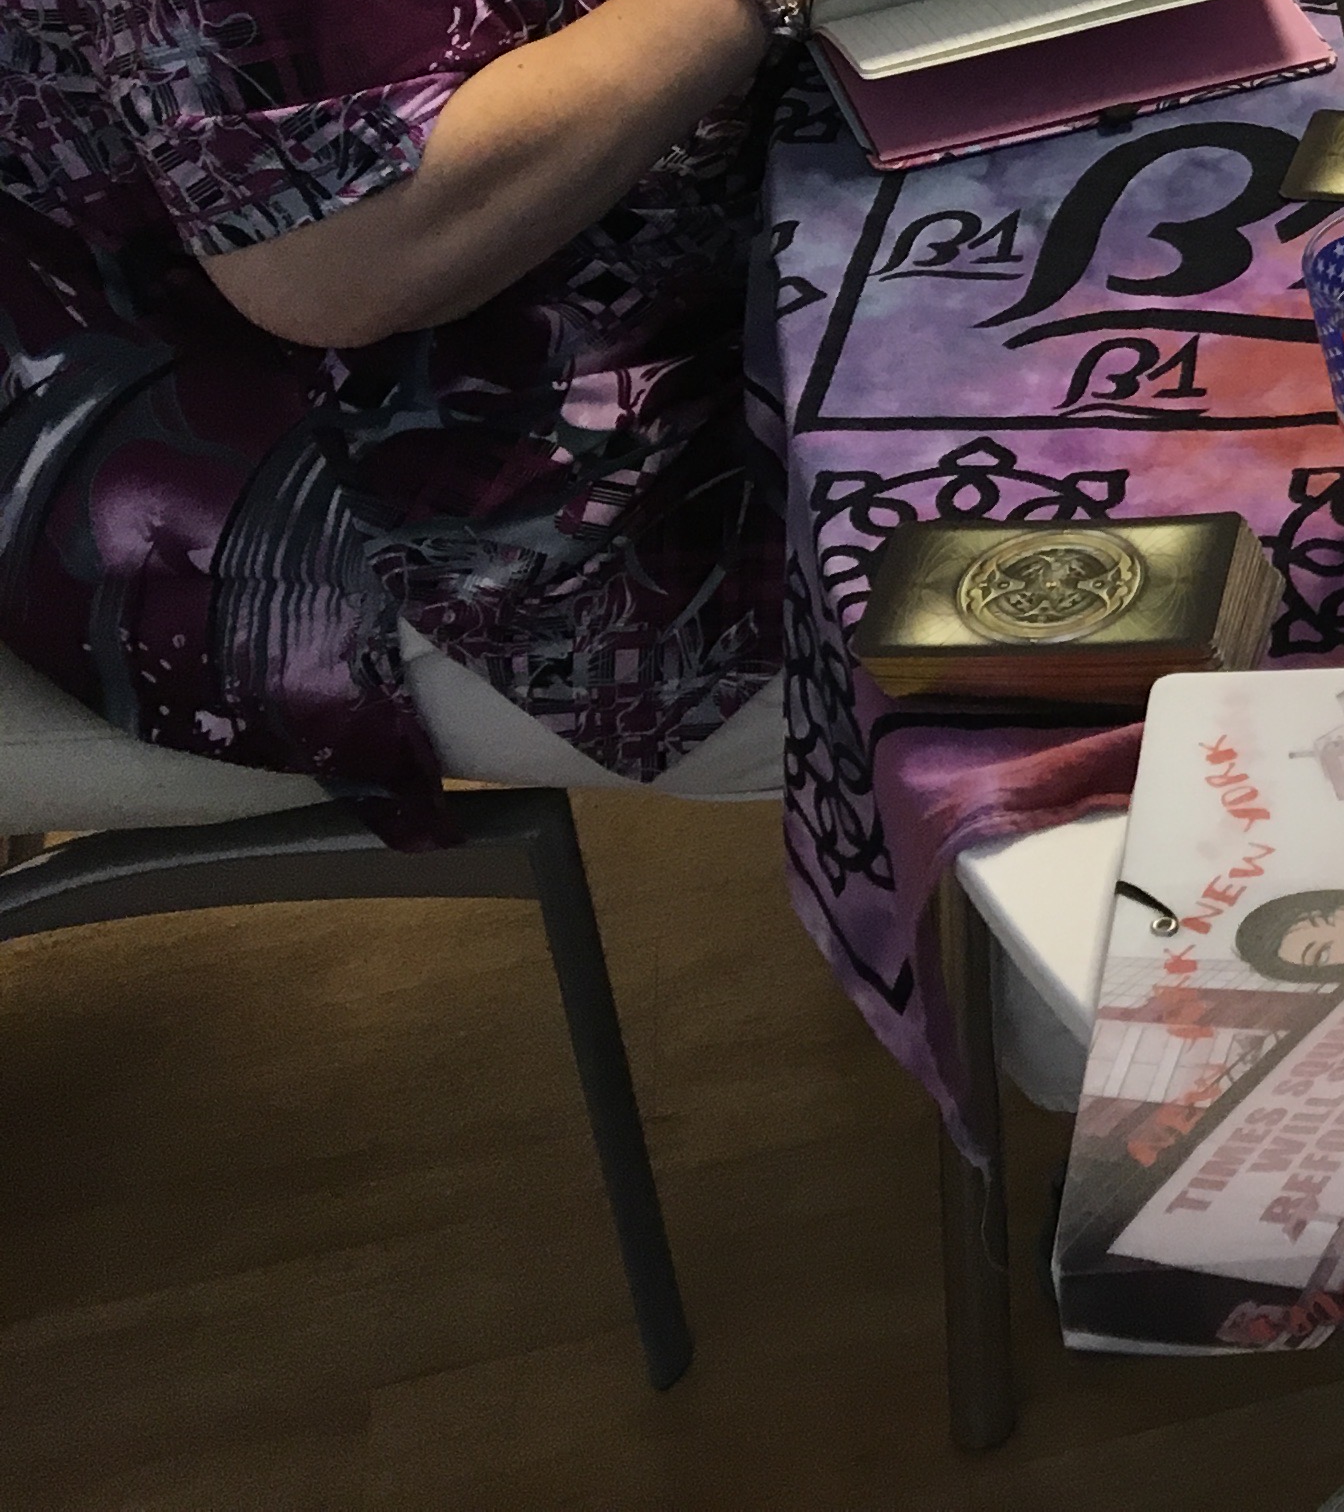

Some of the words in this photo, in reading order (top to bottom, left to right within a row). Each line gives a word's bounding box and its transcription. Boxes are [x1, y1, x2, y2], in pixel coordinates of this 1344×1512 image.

[1200, 734, 1273, 829] YORK
[1180, 840, 1275, 935] NEW
[1166, 1106, 1288, 1215] TIMES
